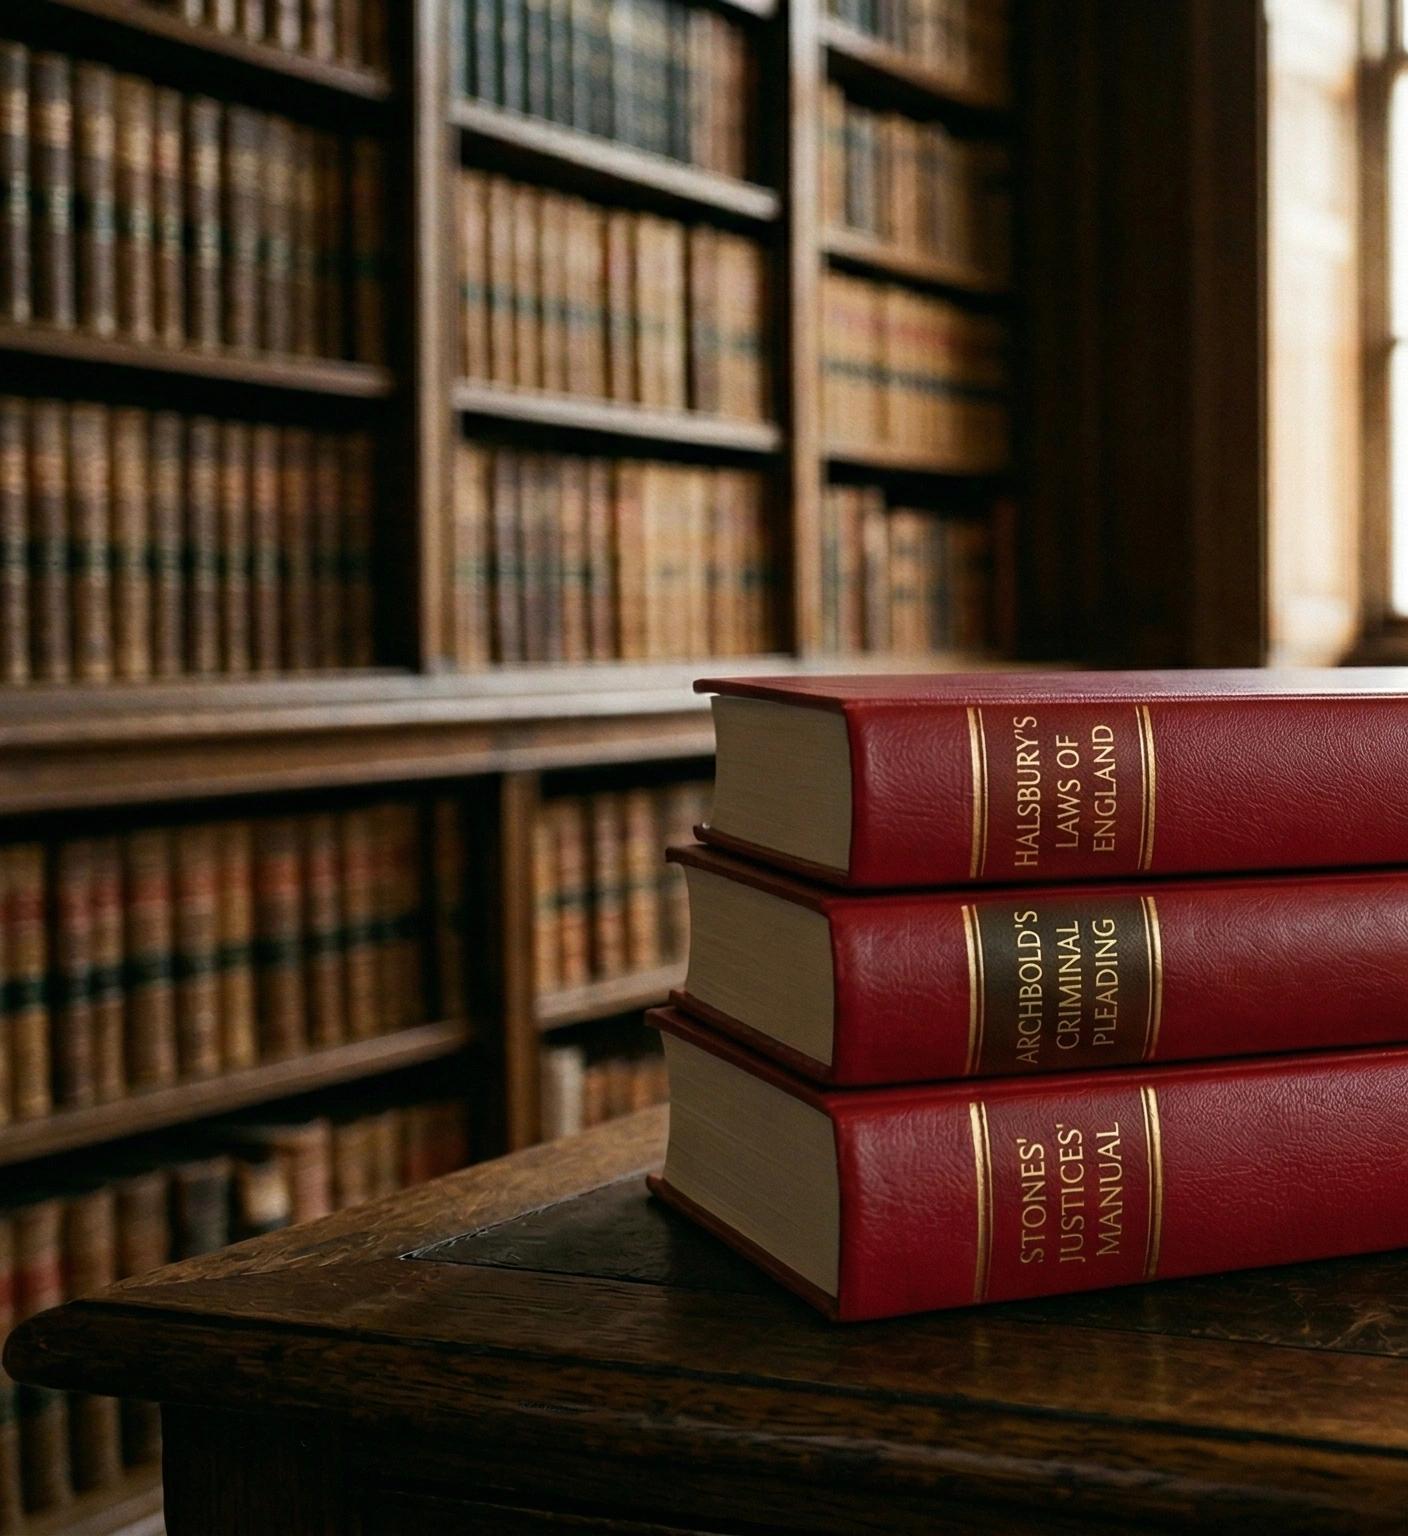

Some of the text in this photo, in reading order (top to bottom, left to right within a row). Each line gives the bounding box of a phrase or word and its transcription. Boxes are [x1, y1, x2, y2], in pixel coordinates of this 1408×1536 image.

[1013, 715, 1040, 866] HALSBURY'S
[1055, 735, 1081, 849] LAWS OF
[1092, 724, 1117, 852] ENGLAND
[1014, 910, 1043, 1064] ARCHBOLD'S
[1056, 920, 1082, 1050] CRIMINAL
[1092, 918, 1118, 1046] PLEADING
[1016, 1138, 1046, 1263] STONES'
[1056, 1123, 1086, 1263] JUSTICES'
[1096, 1122, 1123, 1255] MANUAL
